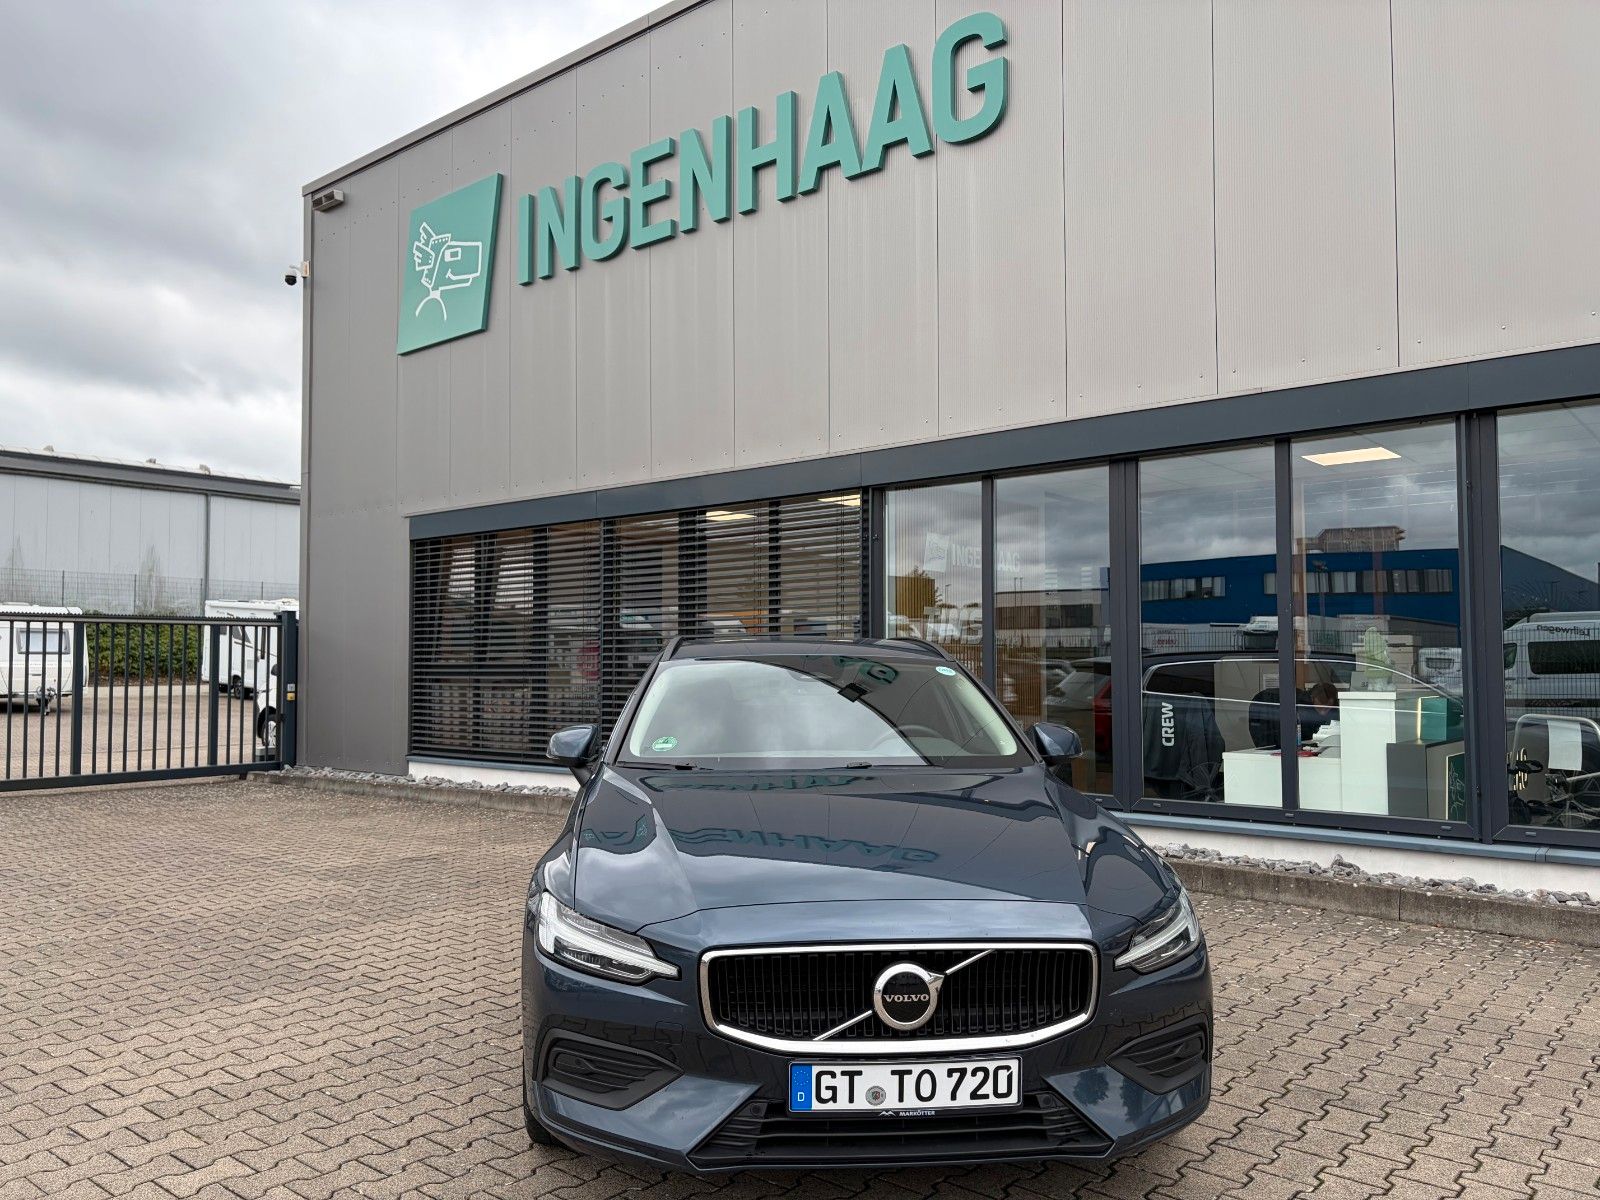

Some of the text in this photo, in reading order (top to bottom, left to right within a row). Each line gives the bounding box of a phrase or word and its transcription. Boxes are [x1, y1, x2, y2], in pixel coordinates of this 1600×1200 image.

[517, 11, 1009, 287] INGENHAAG
[951, 543, 1020, 573] INGEAAG
[1161, 701, 1175, 747] CREW
[883, 994, 930, 1002] VOLVO
[797, 1091, 805, 1102] D
[815, 1070, 863, 1104] GT
[890, 1069, 937, 1103] TO
[946, 1064, 1013, 1101] 720
